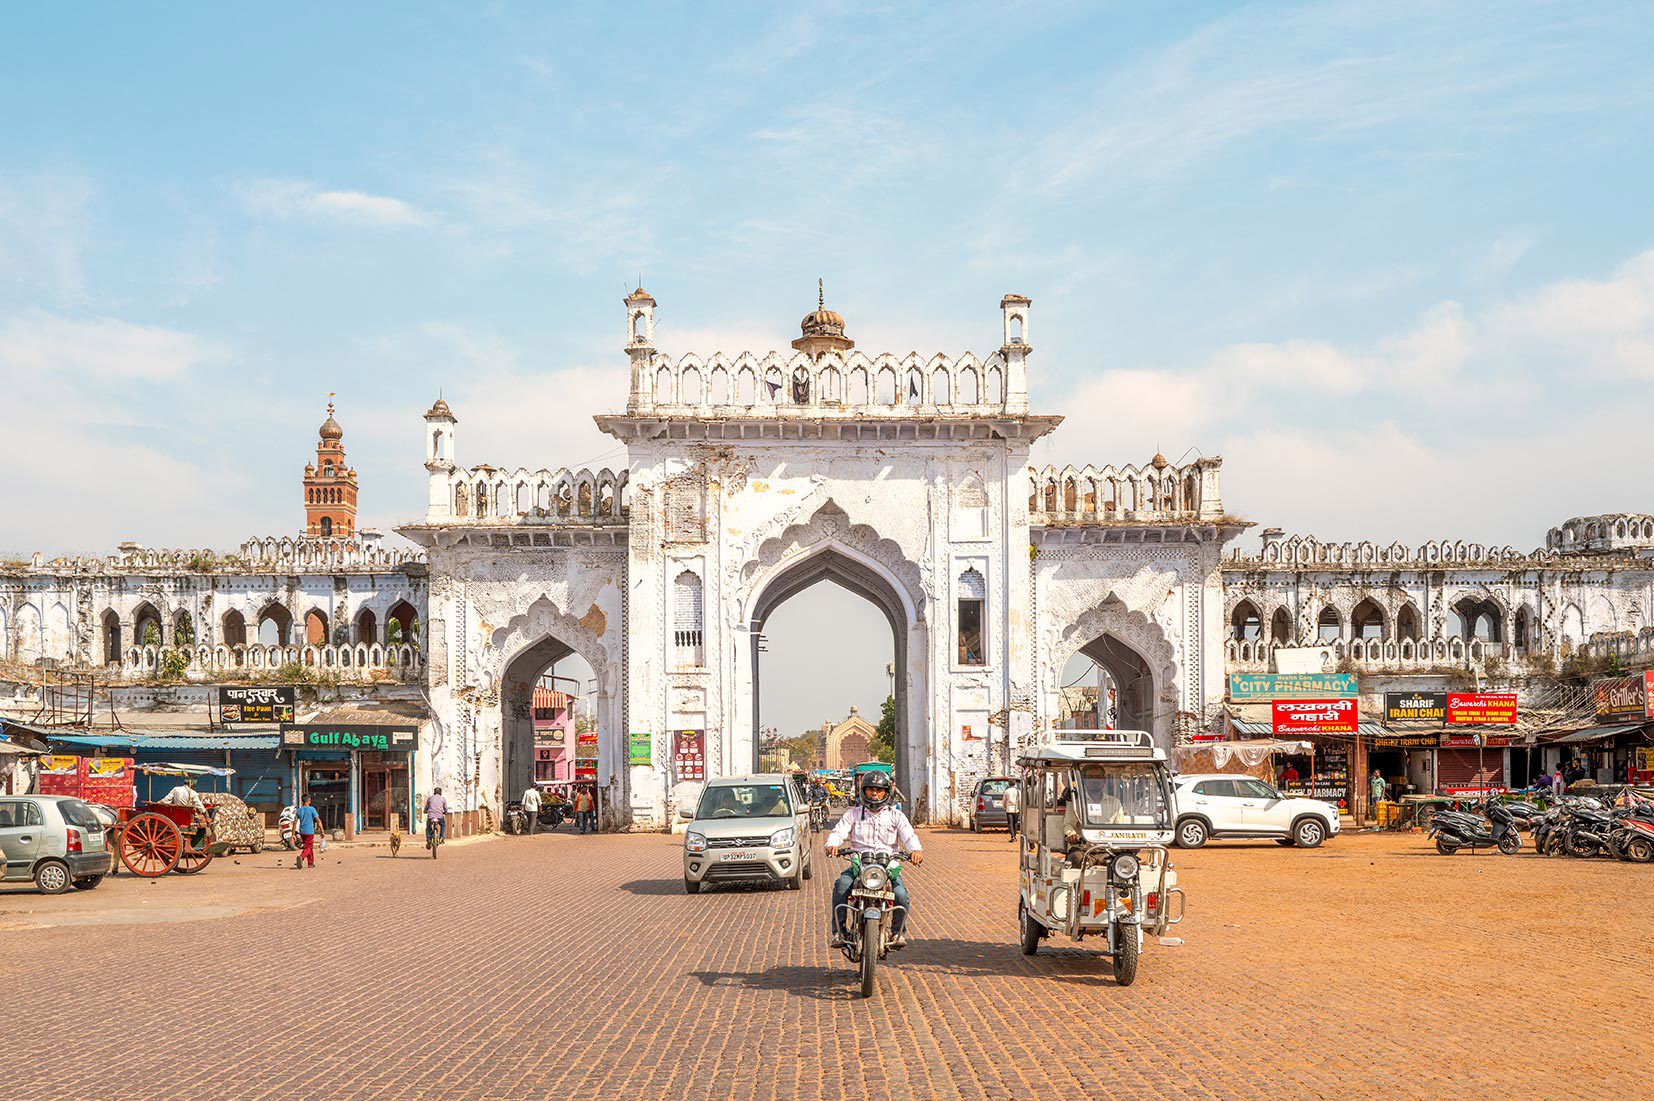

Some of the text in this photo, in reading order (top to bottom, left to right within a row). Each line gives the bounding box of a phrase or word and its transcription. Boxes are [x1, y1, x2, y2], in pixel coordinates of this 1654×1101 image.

[1240, 680, 1350, 692] CITY PHARMACY
[1610, 687, 1644, 707] Griller's
[1276, 700, 1353, 711] लखनवी
[1399, 699, 1434, 708] SHARIF
[1450, 698, 1487, 708] Bawarchi
[1290, 710, 1340, 721] नहारी
[1389, 708, 1444, 718] IRANI CHAI
[1277, 724, 1321, 732] Bawarchi
[309, 732, 387, 747] Gulf Abaya
[1421, 737, 1437, 745] CHAI
